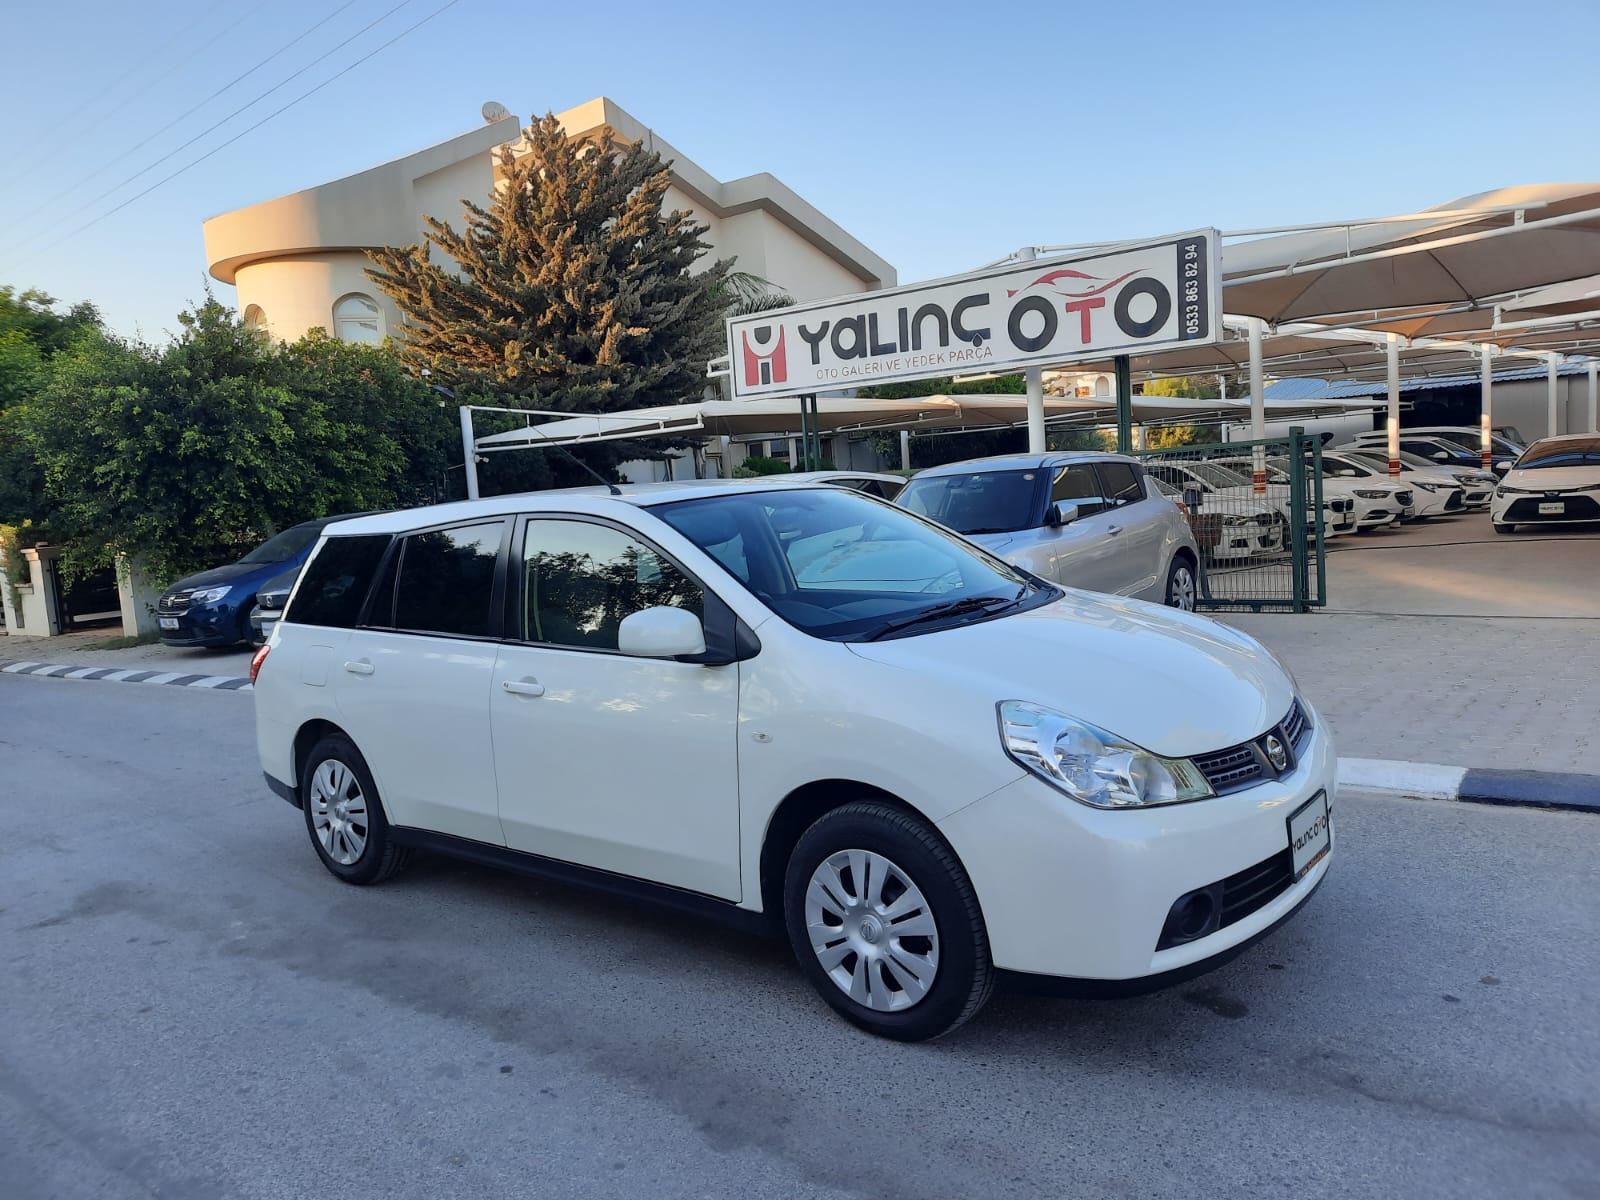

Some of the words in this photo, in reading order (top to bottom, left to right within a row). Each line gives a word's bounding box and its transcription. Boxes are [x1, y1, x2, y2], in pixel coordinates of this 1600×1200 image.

[1185, 244, 1198, 259] 94
[1185, 262, 1198, 278] 82
[1186, 280, 1198, 302] 863
[1008, 276, 1172, 352] OTO
[1186, 305, 1199, 334] 0533
[816, 369, 838, 380] OTO
[842, 362, 883, 377] GALERİ
[886, 359, 901, 371] VE
[904, 352, 945, 369] YEDEK
[949, 346, 993, 362] PARÇA
